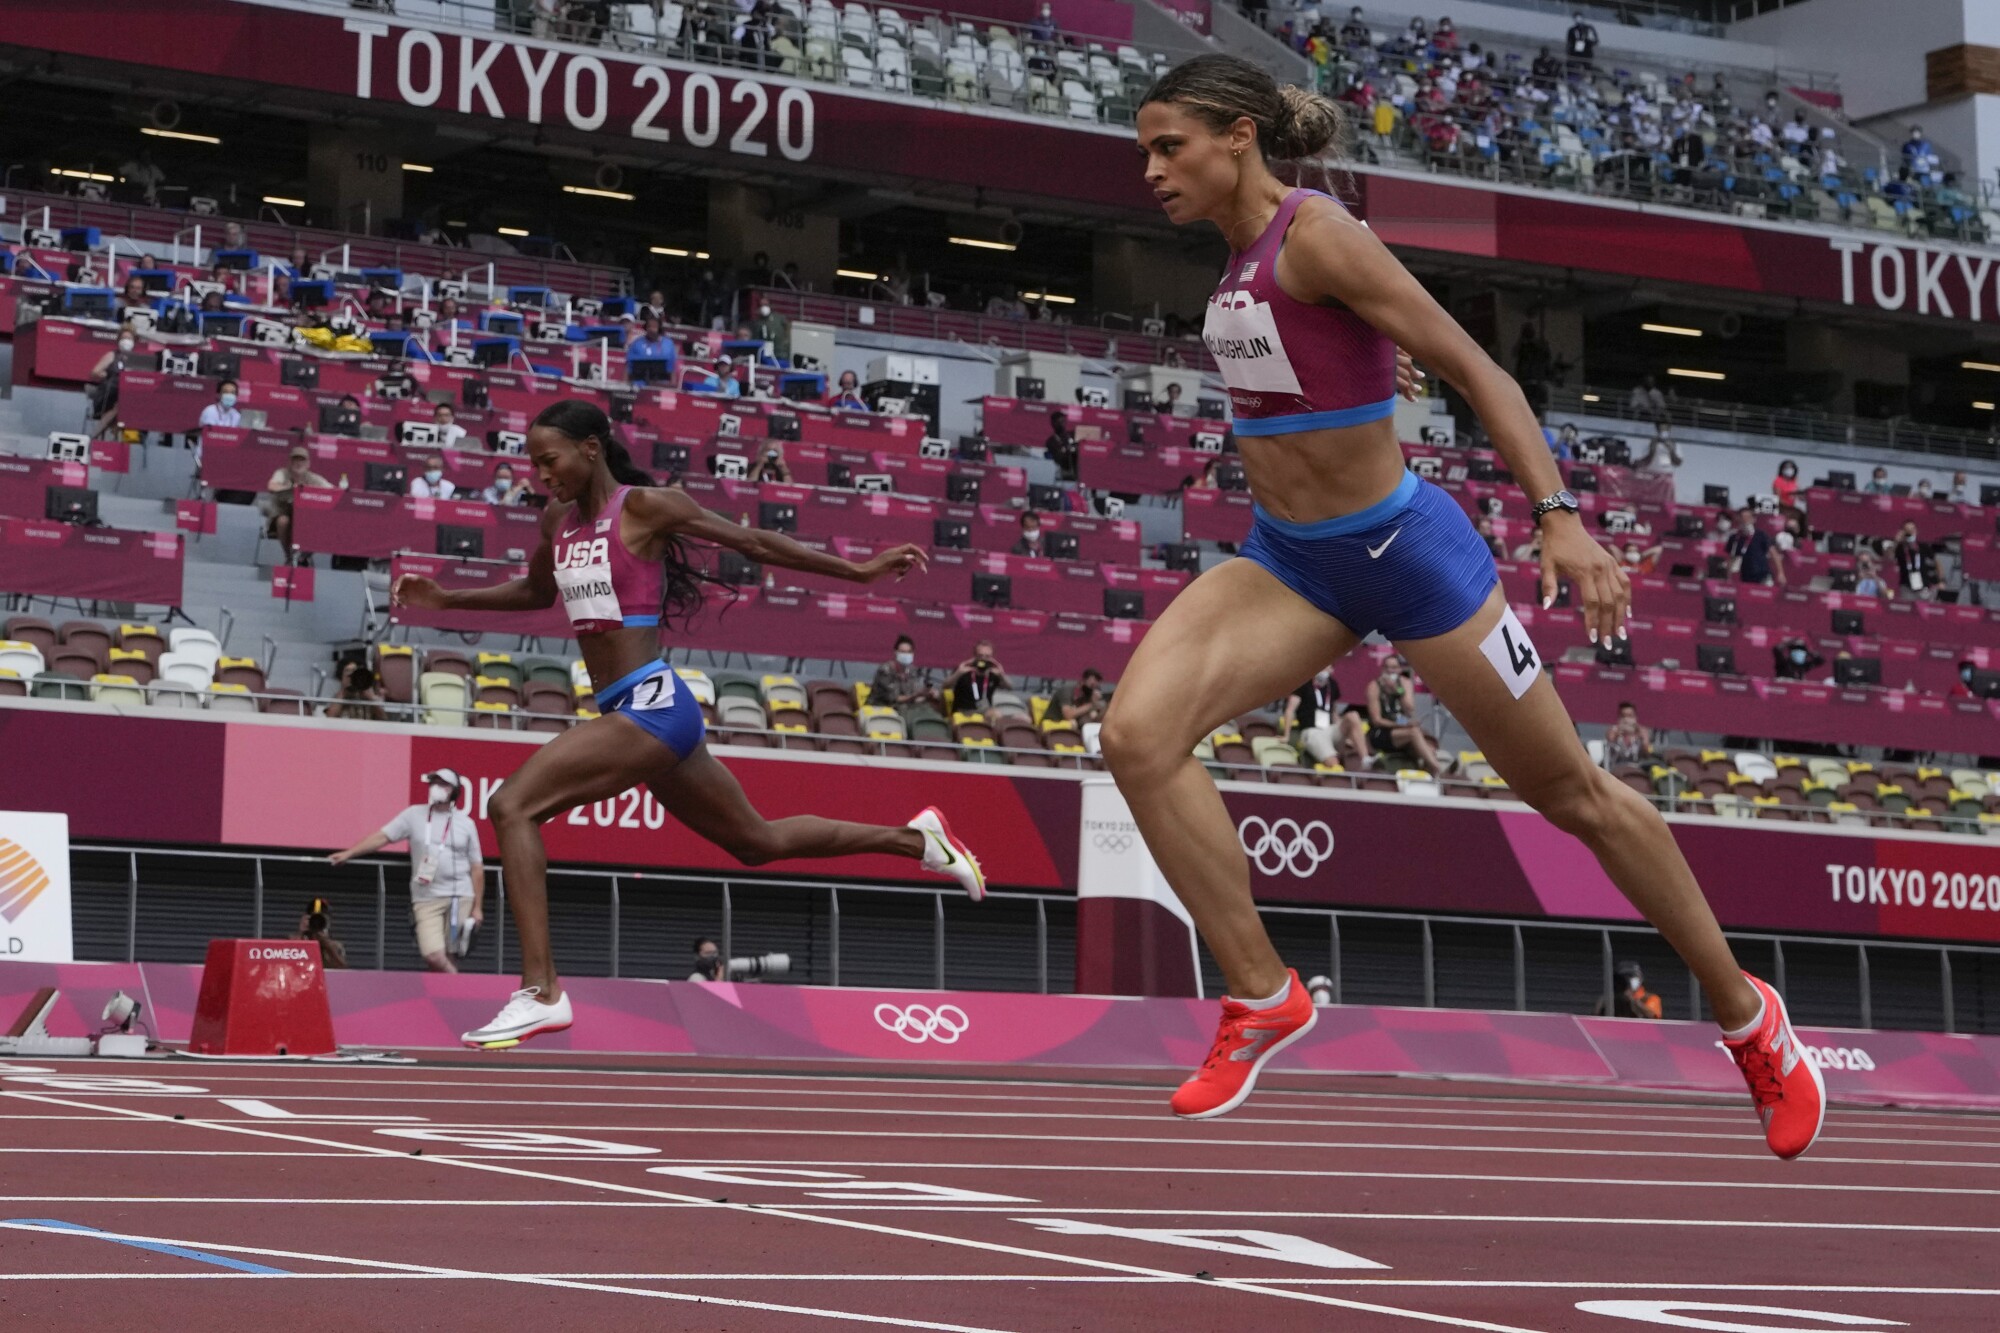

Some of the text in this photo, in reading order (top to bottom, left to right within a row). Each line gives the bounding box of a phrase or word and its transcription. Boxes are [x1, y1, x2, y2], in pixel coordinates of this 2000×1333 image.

[343, 17, 815, 162] TOKYO 2020
[1829, 237, 2000, 322] TOKY
[554, 537, 609, 571] USA
[1501, 624, 1536, 676] 4
[642, 675, 664, 706] 7
[1826, 864, 2000, 912] TOKYO 2020
[262, 947, 309, 960] OMEGA
[1806, 1045, 1876, 1071] 2020
